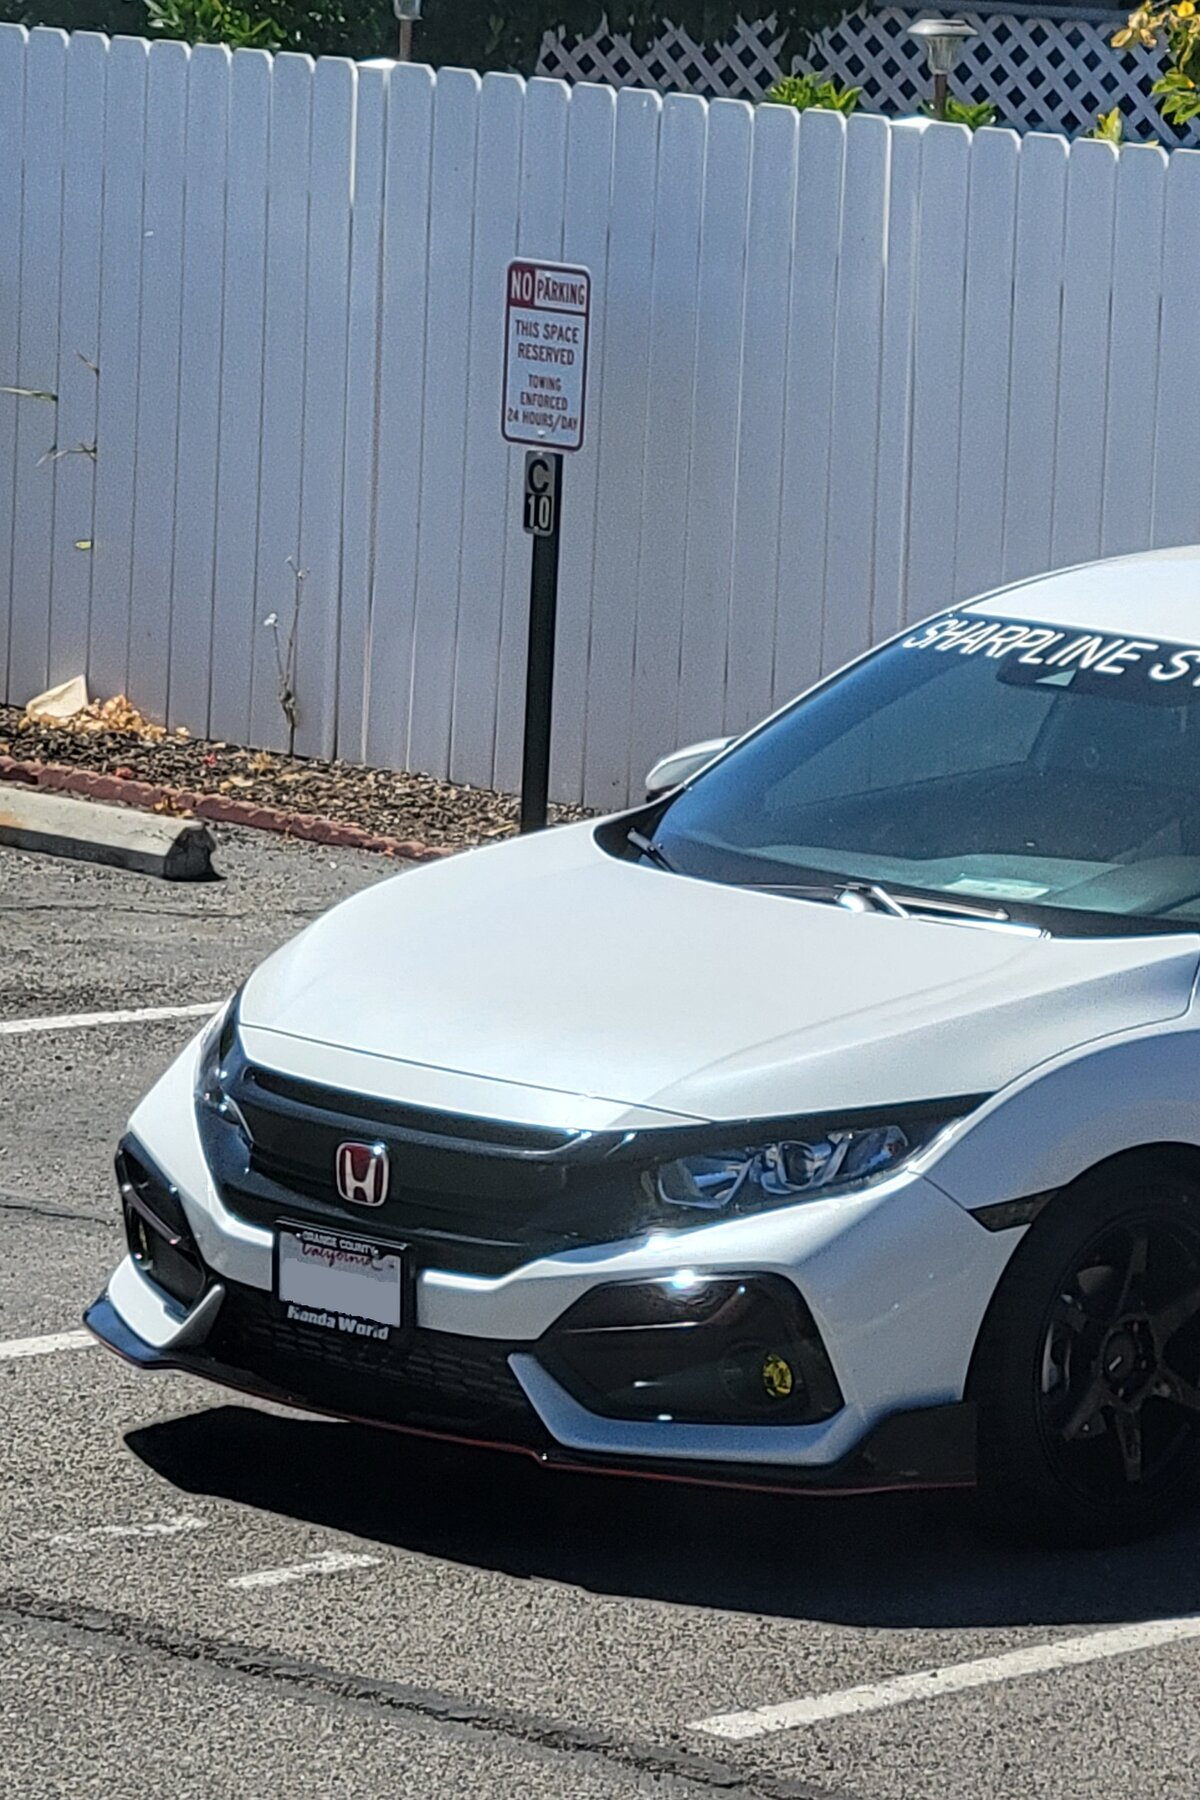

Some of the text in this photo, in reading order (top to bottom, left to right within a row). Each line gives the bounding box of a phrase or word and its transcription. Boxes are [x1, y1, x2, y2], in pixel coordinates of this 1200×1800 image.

[511, 270, 586, 306] NO PARKING
[515, 319, 580, 344] THIS SPACE
[518, 342, 575, 366] RESERVED
[528, 373, 562, 392] TOWING
[520, 391, 569, 411] ENFORCED
[507, 407, 577, 433] 24 HOURS/DAY
[528, 459, 549, 493] C
[528, 495, 549, 529] 10
[902, 618, 1159, 674] SHARPLINE
[340, 1239, 376, 1256] COUNTY
[287, 1305, 389, 1340] Honda World
